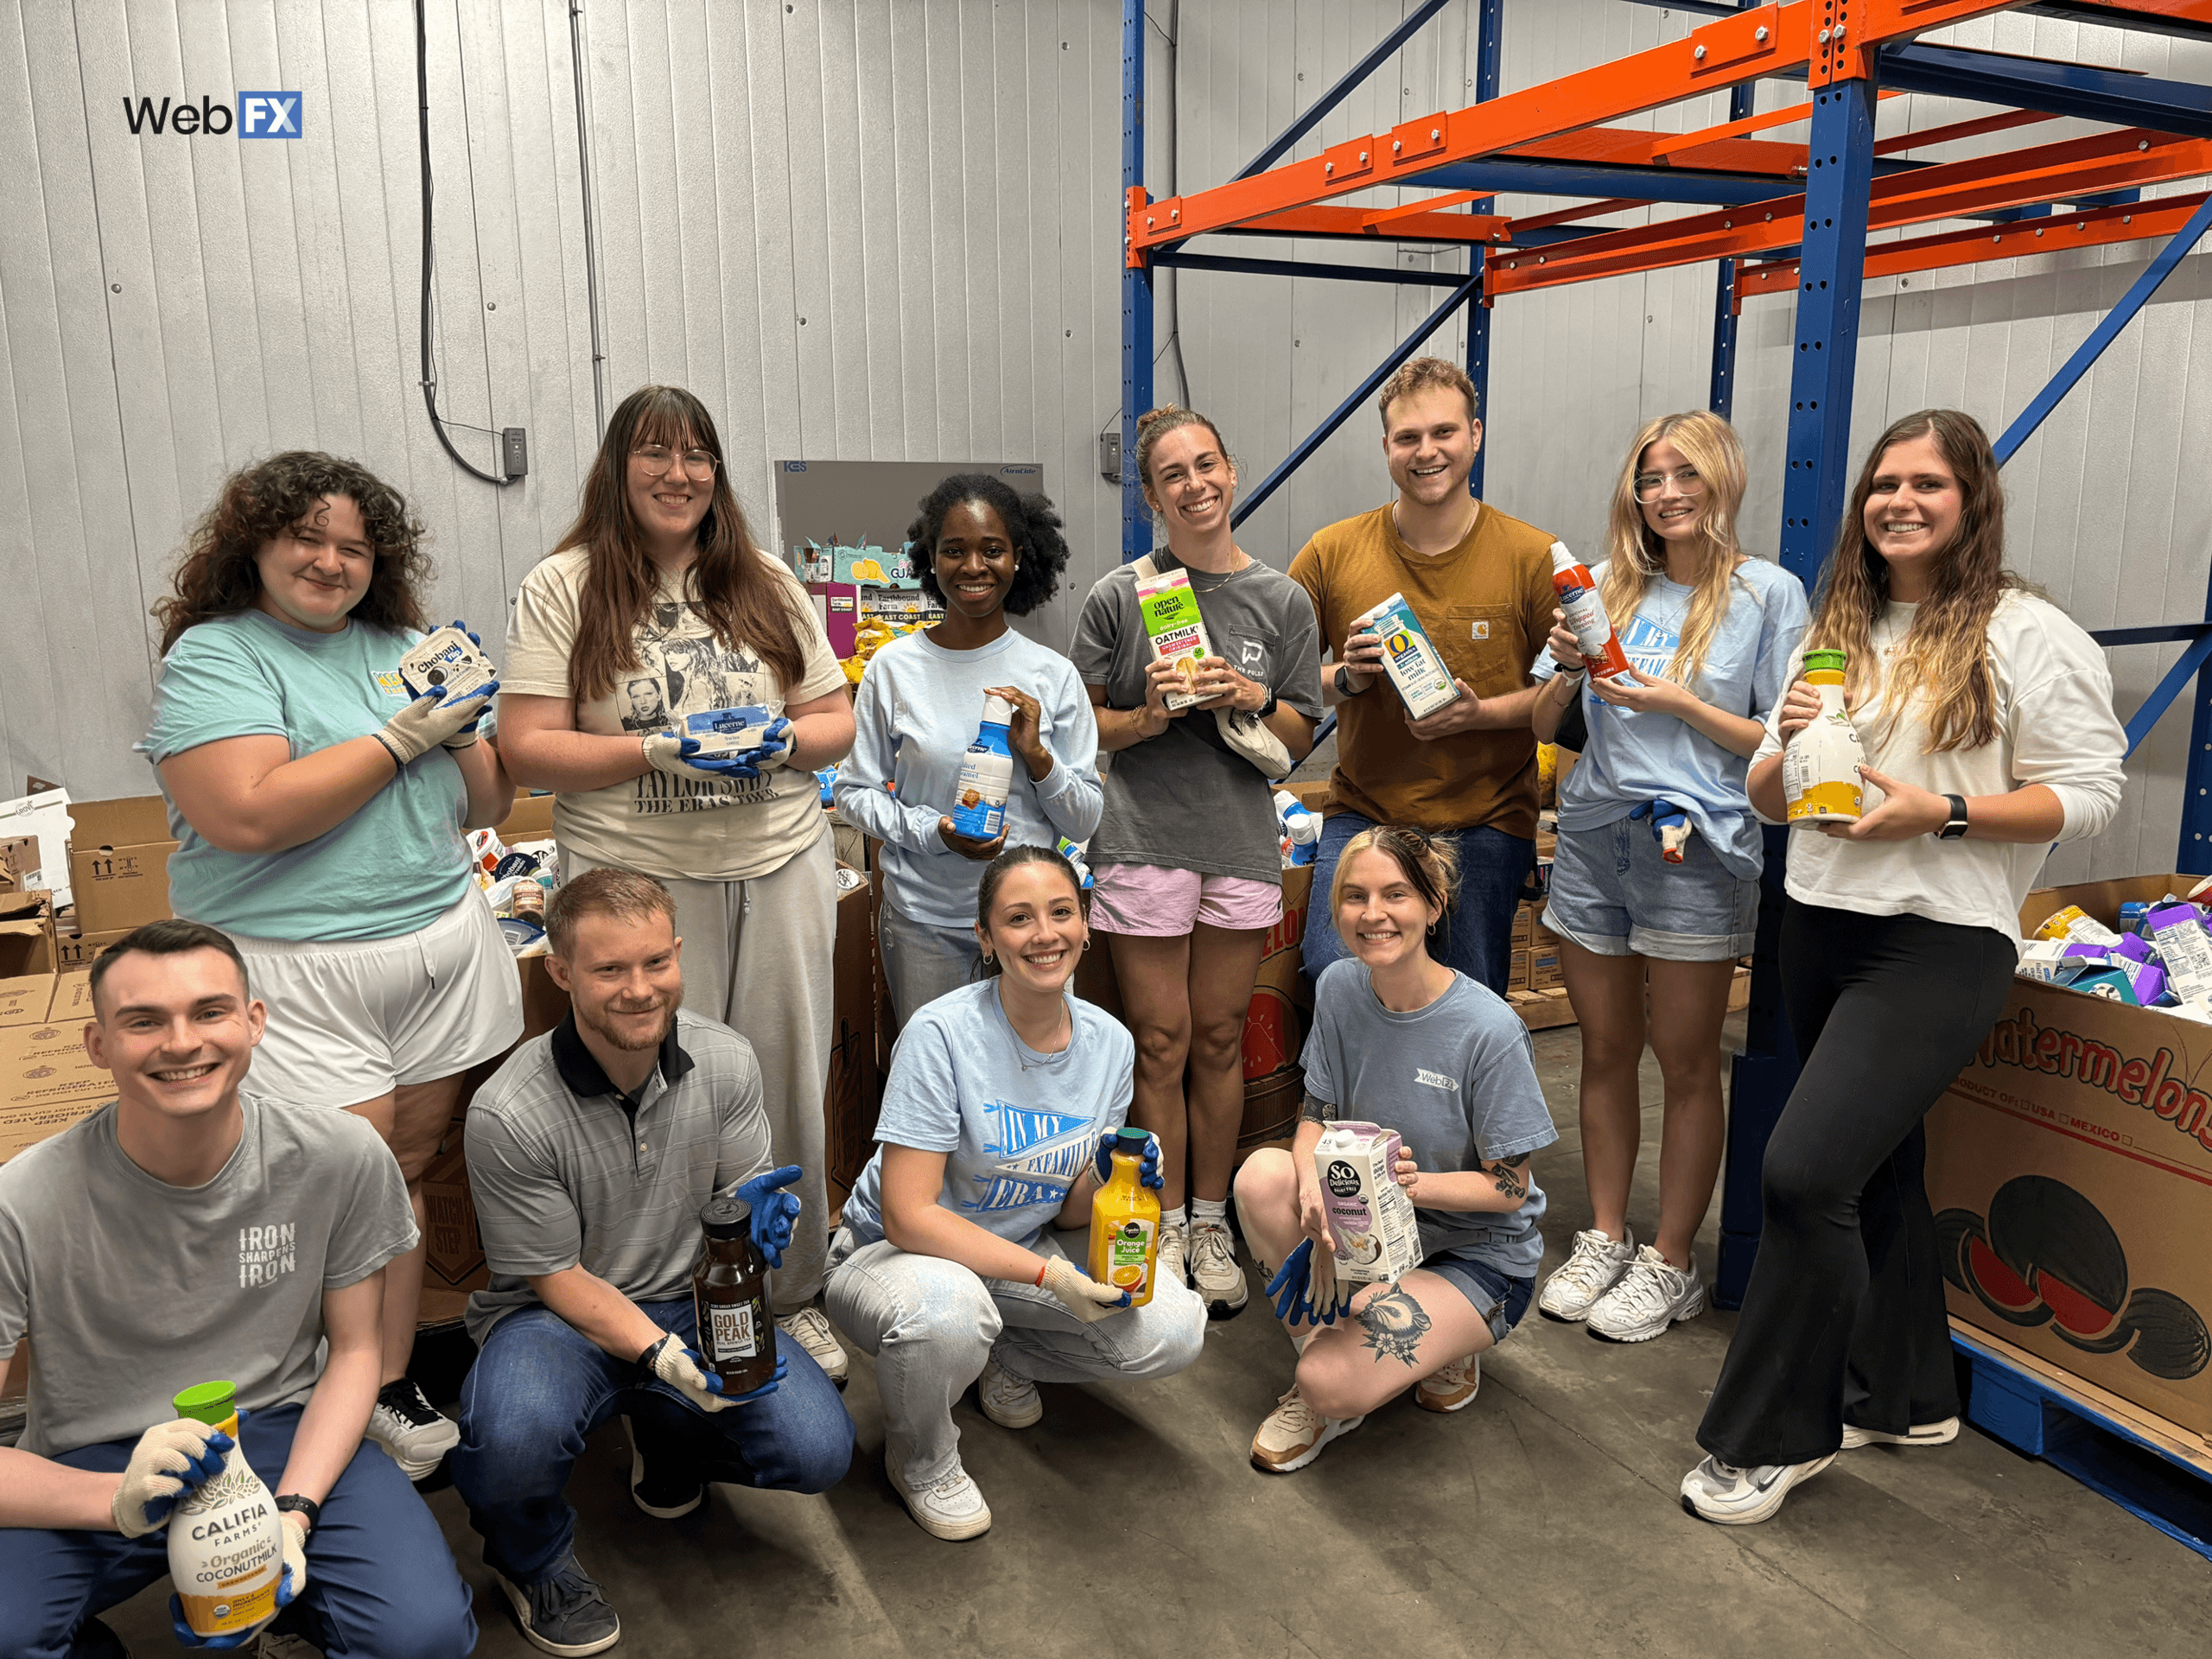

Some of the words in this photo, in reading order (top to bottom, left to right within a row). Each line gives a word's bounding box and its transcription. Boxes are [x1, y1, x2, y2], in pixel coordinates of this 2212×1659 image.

[878, 594, 920, 602] Earthbound
[1154, 596, 1179, 609] open
[1154, 602, 1184, 617] nature
[1155, 626, 1198, 645] OATMILK
[417, 640, 459, 674] Chobani
[1400, 664, 1414, 677] low
[1414, 658, 1427, 668] fat
[1408, 667, 1427, 681] milk
[715, 720, 745, 730] Lucerne
[634, 800, 673, 813] THE
[679, 797, 730, 812] ERAS
[27, 1080, 114, 1095] REFRIGERATE
[1953, 1076, 1998, 1098] RODUCT
[2031, 1103, 2056, 1121] USA
[2069, 1116, 2120, 1141] MEXICO
[1007, 1109, 1027, 1153] IN
[1033, 1114, 1063, 1141] MY
[1331, 1165, 1355, 1179] SO
[988, 1179, 1044, 1209] ERA
[239, 1223, 296, 1251] IRON
[1117, 1239, 1145, 1248] Orange
[239, 1242, 296, 1263] SHARPENS
[239, 1252, 296, 1288] IRON
[714, 1311, 749, 1328] GOLD
[715, 1324, 751, 1341] PEAK
[192, 1503, 268, 1541] CALIFIA
[214, 1524, 257, 1547] FARMS
[196, 1543, 277, 1582] COCONUTMILK
[211, 1539, 266, 1568] Organic
